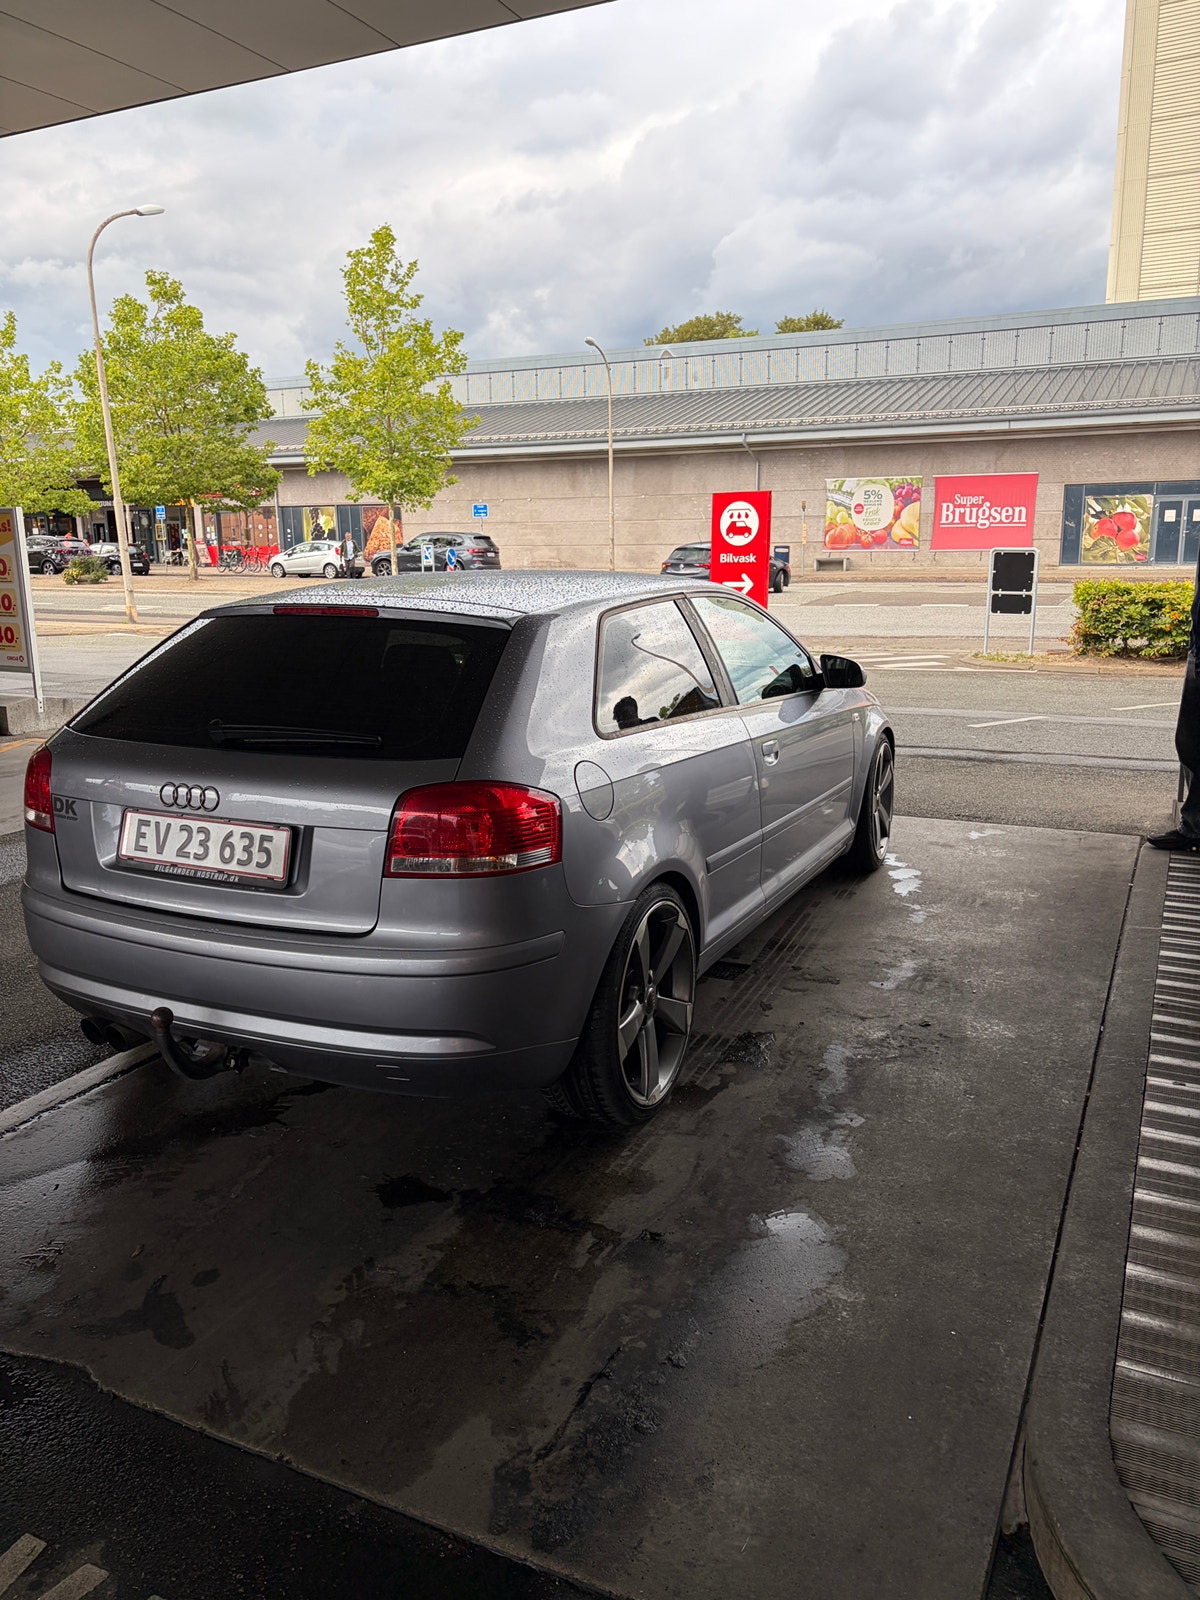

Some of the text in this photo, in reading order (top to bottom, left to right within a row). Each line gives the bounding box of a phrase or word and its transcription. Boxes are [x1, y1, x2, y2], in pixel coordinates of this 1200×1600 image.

[863, 489, 883, 500] 5%
[954, 493, 985, 507] Super
[940, 502, 1027, 529] Brugsen
[0, 519, 12, 532] s!
[719, 553, 756, 563] Bilvask
[0, 593, 17, 612] 0,-
[53, 796, 78, 816] DK
[134, 818, 274, 869] EV 23 635
